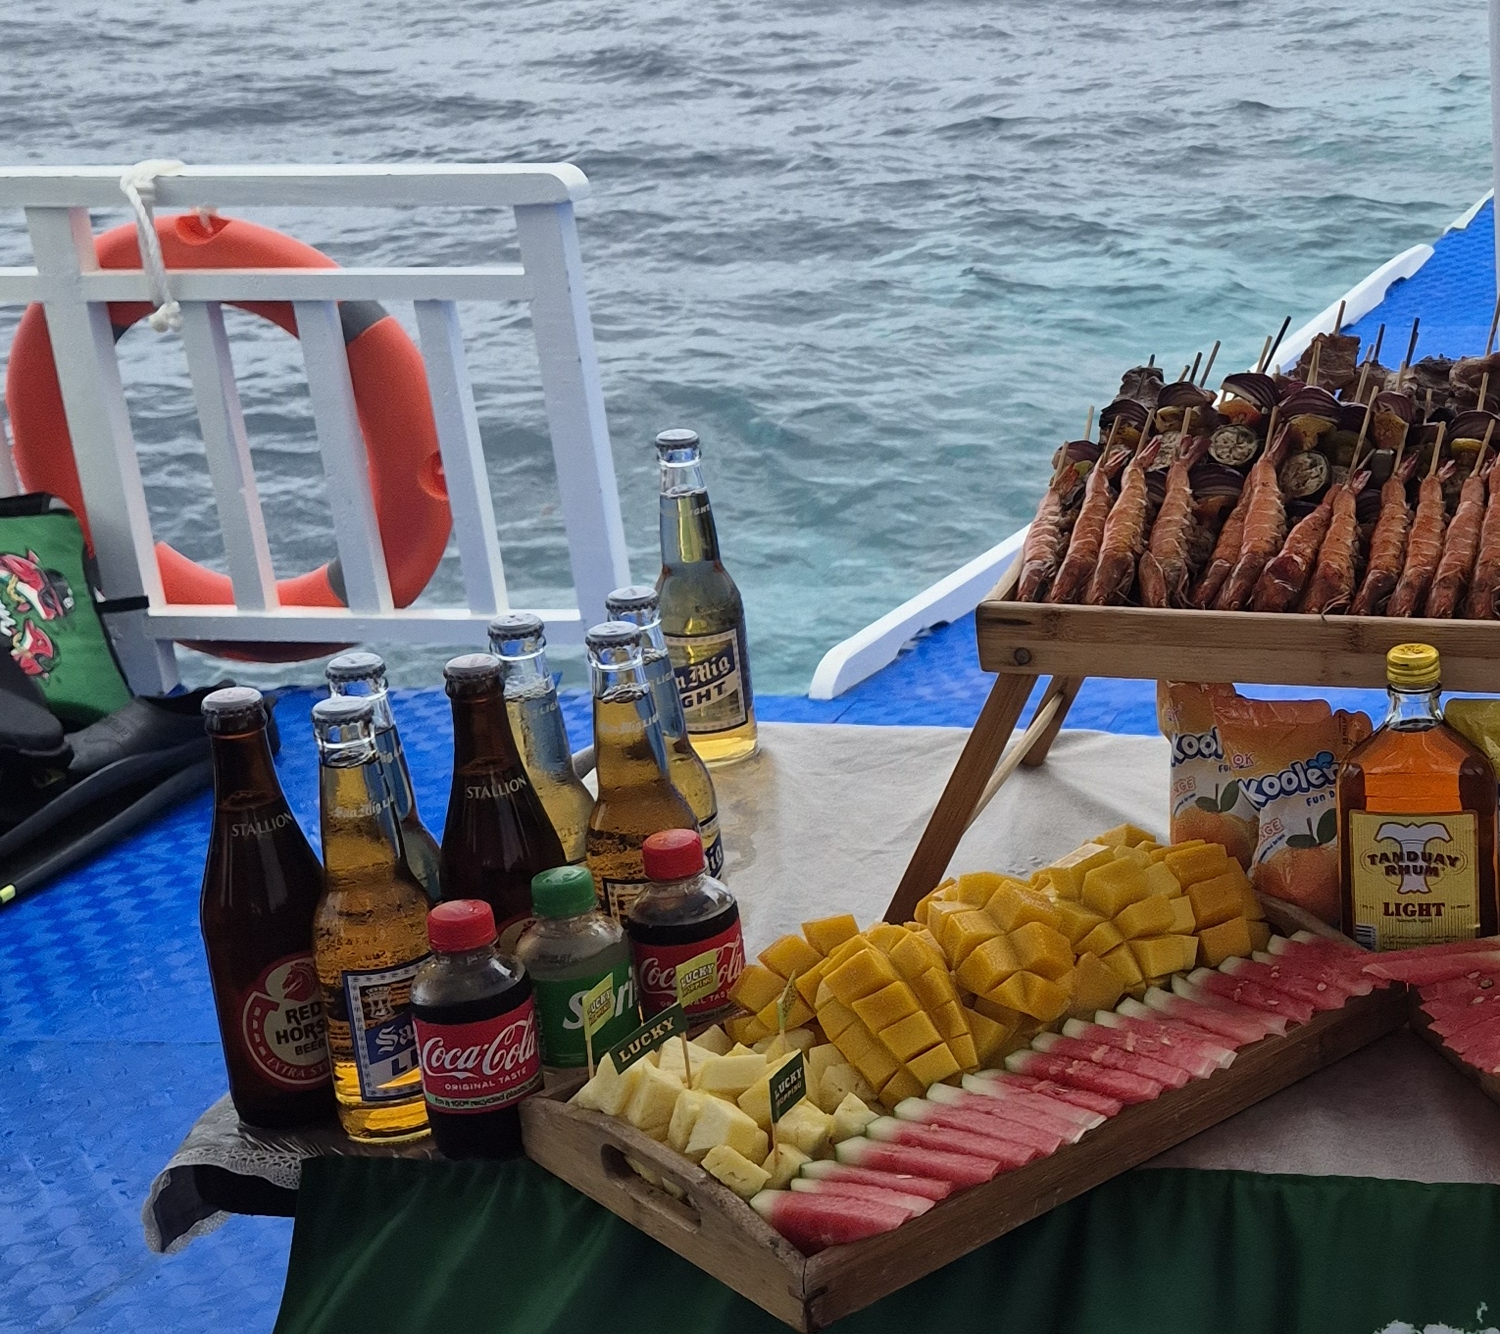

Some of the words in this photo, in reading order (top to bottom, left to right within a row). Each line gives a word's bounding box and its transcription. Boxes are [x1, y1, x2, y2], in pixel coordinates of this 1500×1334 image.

[681, 681, 726, 709] GHT
[1171, 725, 1225, 768] Kool
[467, 774, 528, 799] STALLION
[1236, 760, 1339, 812] Kooler
[230, 811, 294, 838] STALLION
[1366, 851, 1460, 868] TANDUAY
[1384, 864, 1440, 878] RHUM
[1382, 902, 1446, 917] LIGHT
[680, 963, 715, 989] LUCKY
[285, 1001, 321, 1025] RED
[275, 1019, 326, 1045] HORS
[422, 1010, 535, 1079] Coca-Cola
[618, 1016, 675, 1063] LUCKY
[444, 1080, 496, 1091] ORIGINAL
[498, 1066, 527, 1085] TASTE
[774, 1067, 803, 1100] LUCKY
